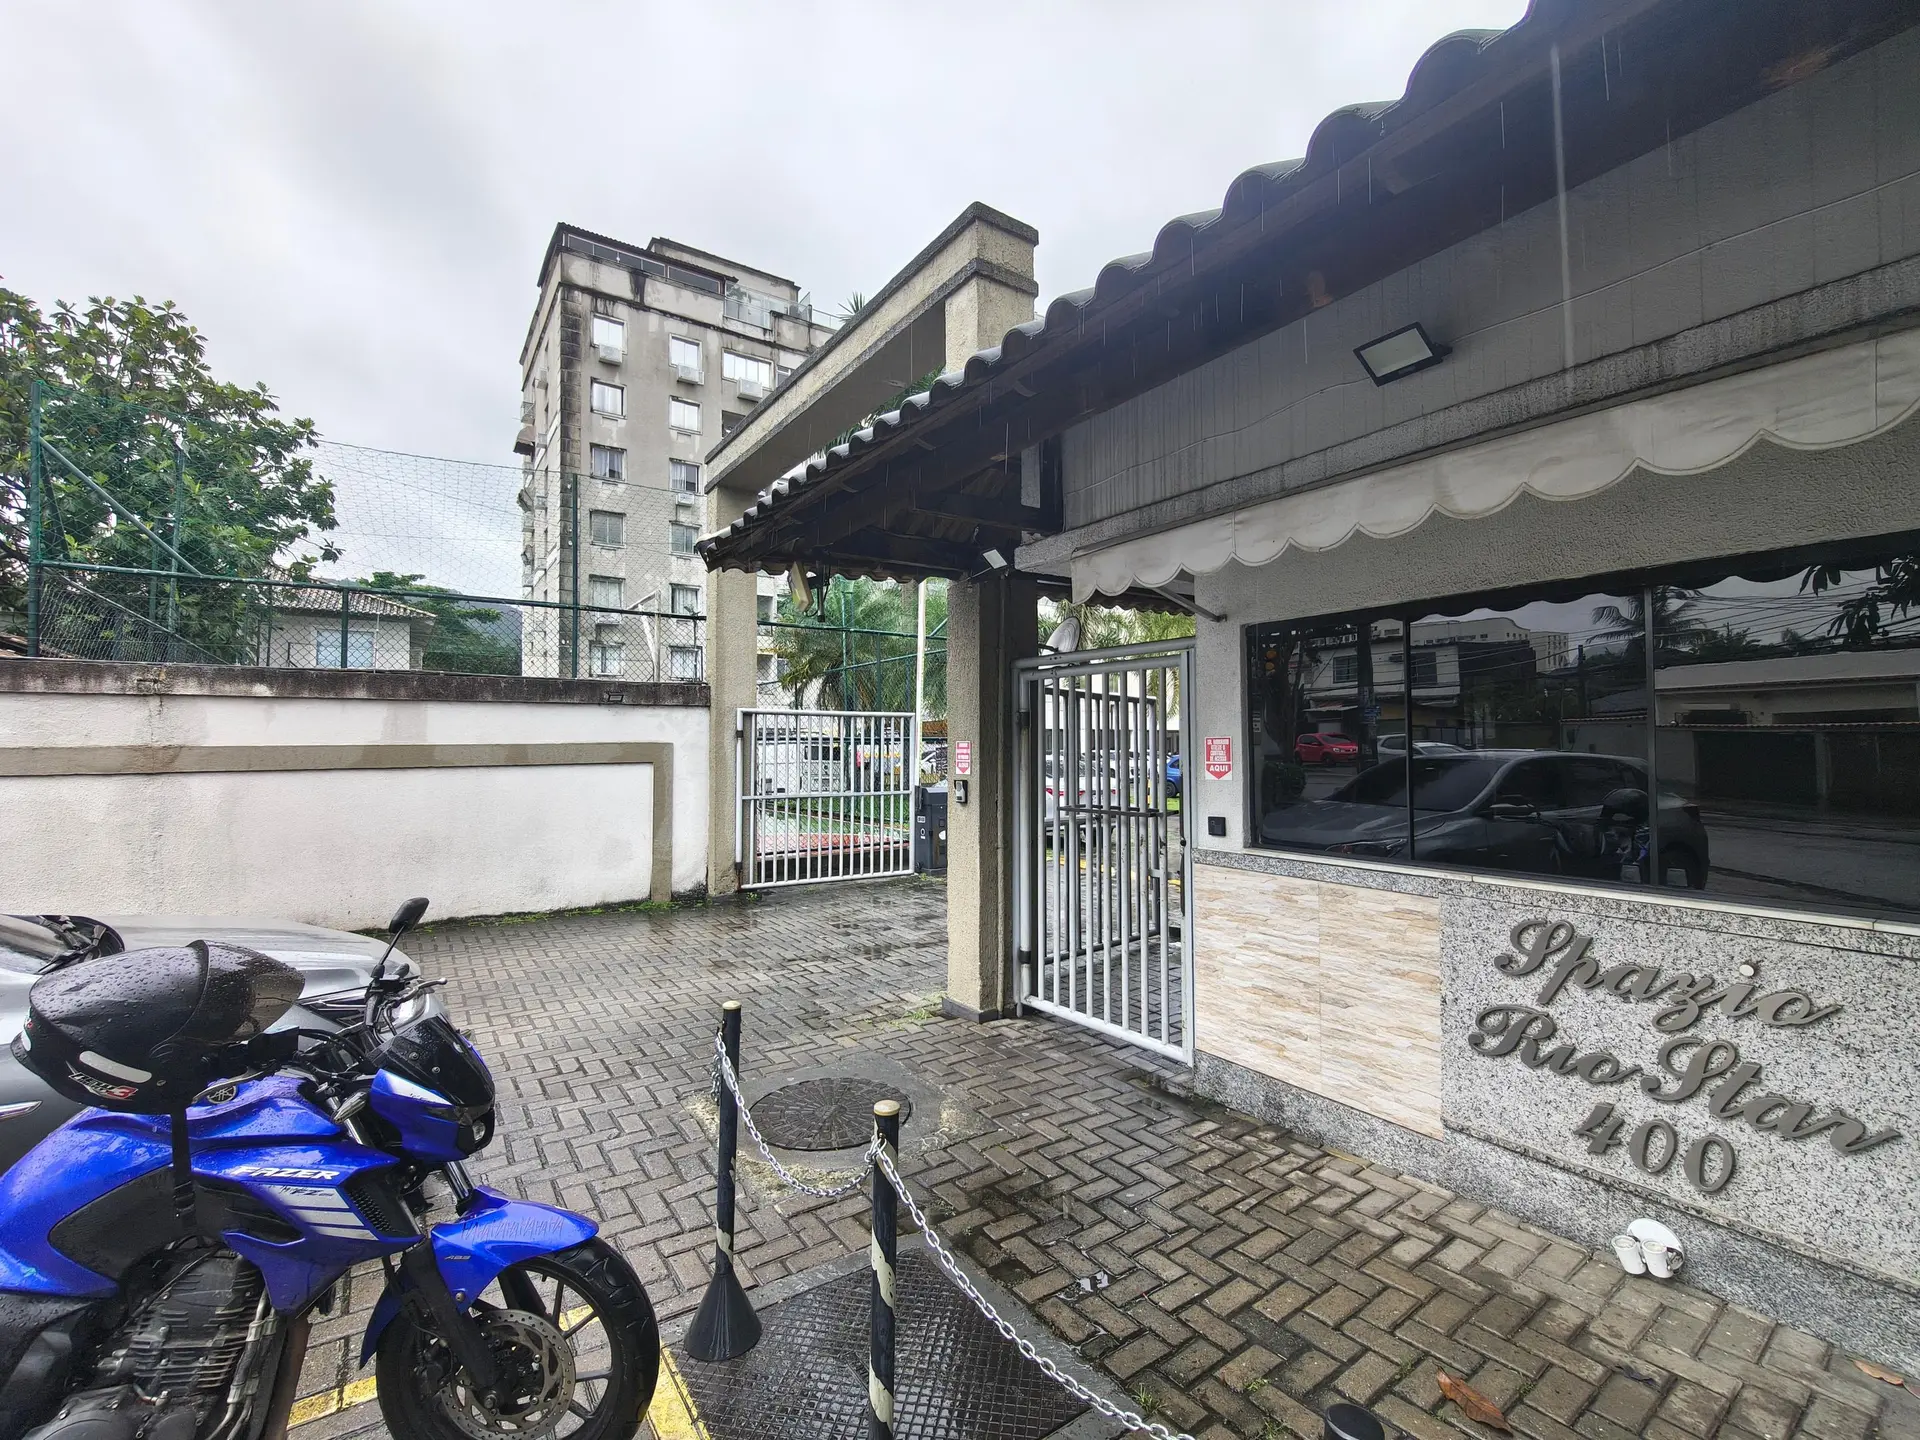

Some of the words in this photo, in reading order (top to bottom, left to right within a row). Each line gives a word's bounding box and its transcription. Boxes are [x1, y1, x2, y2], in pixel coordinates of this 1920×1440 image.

[1209, 764, 1228, 772] AQUI
[1493, 919, 1843, 1032] Spazio
[1467, 1003, 1643, 1085] Rio
[1640, 1036, 1902, 1156] Star
[230, 1165, 340, 1180] FAZER
[1573, 1102, 1736, 1194] 400
